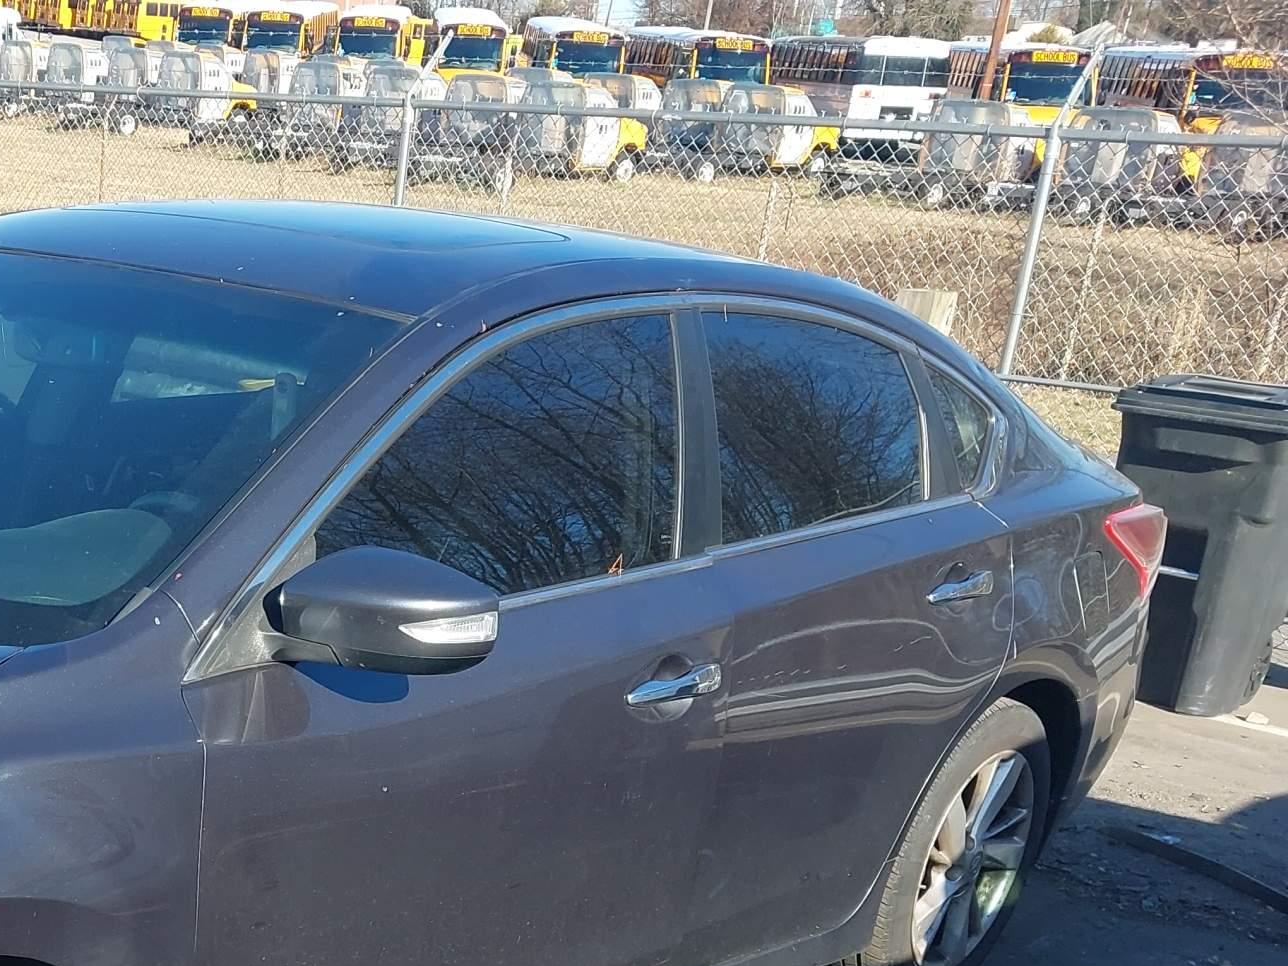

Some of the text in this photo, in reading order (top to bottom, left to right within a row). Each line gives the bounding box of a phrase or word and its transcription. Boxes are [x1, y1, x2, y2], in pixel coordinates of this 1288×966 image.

[718, 39, 751, 49] SCHOOL BUS
[1035, 52, 1076, 63] SCHOOL BUS
